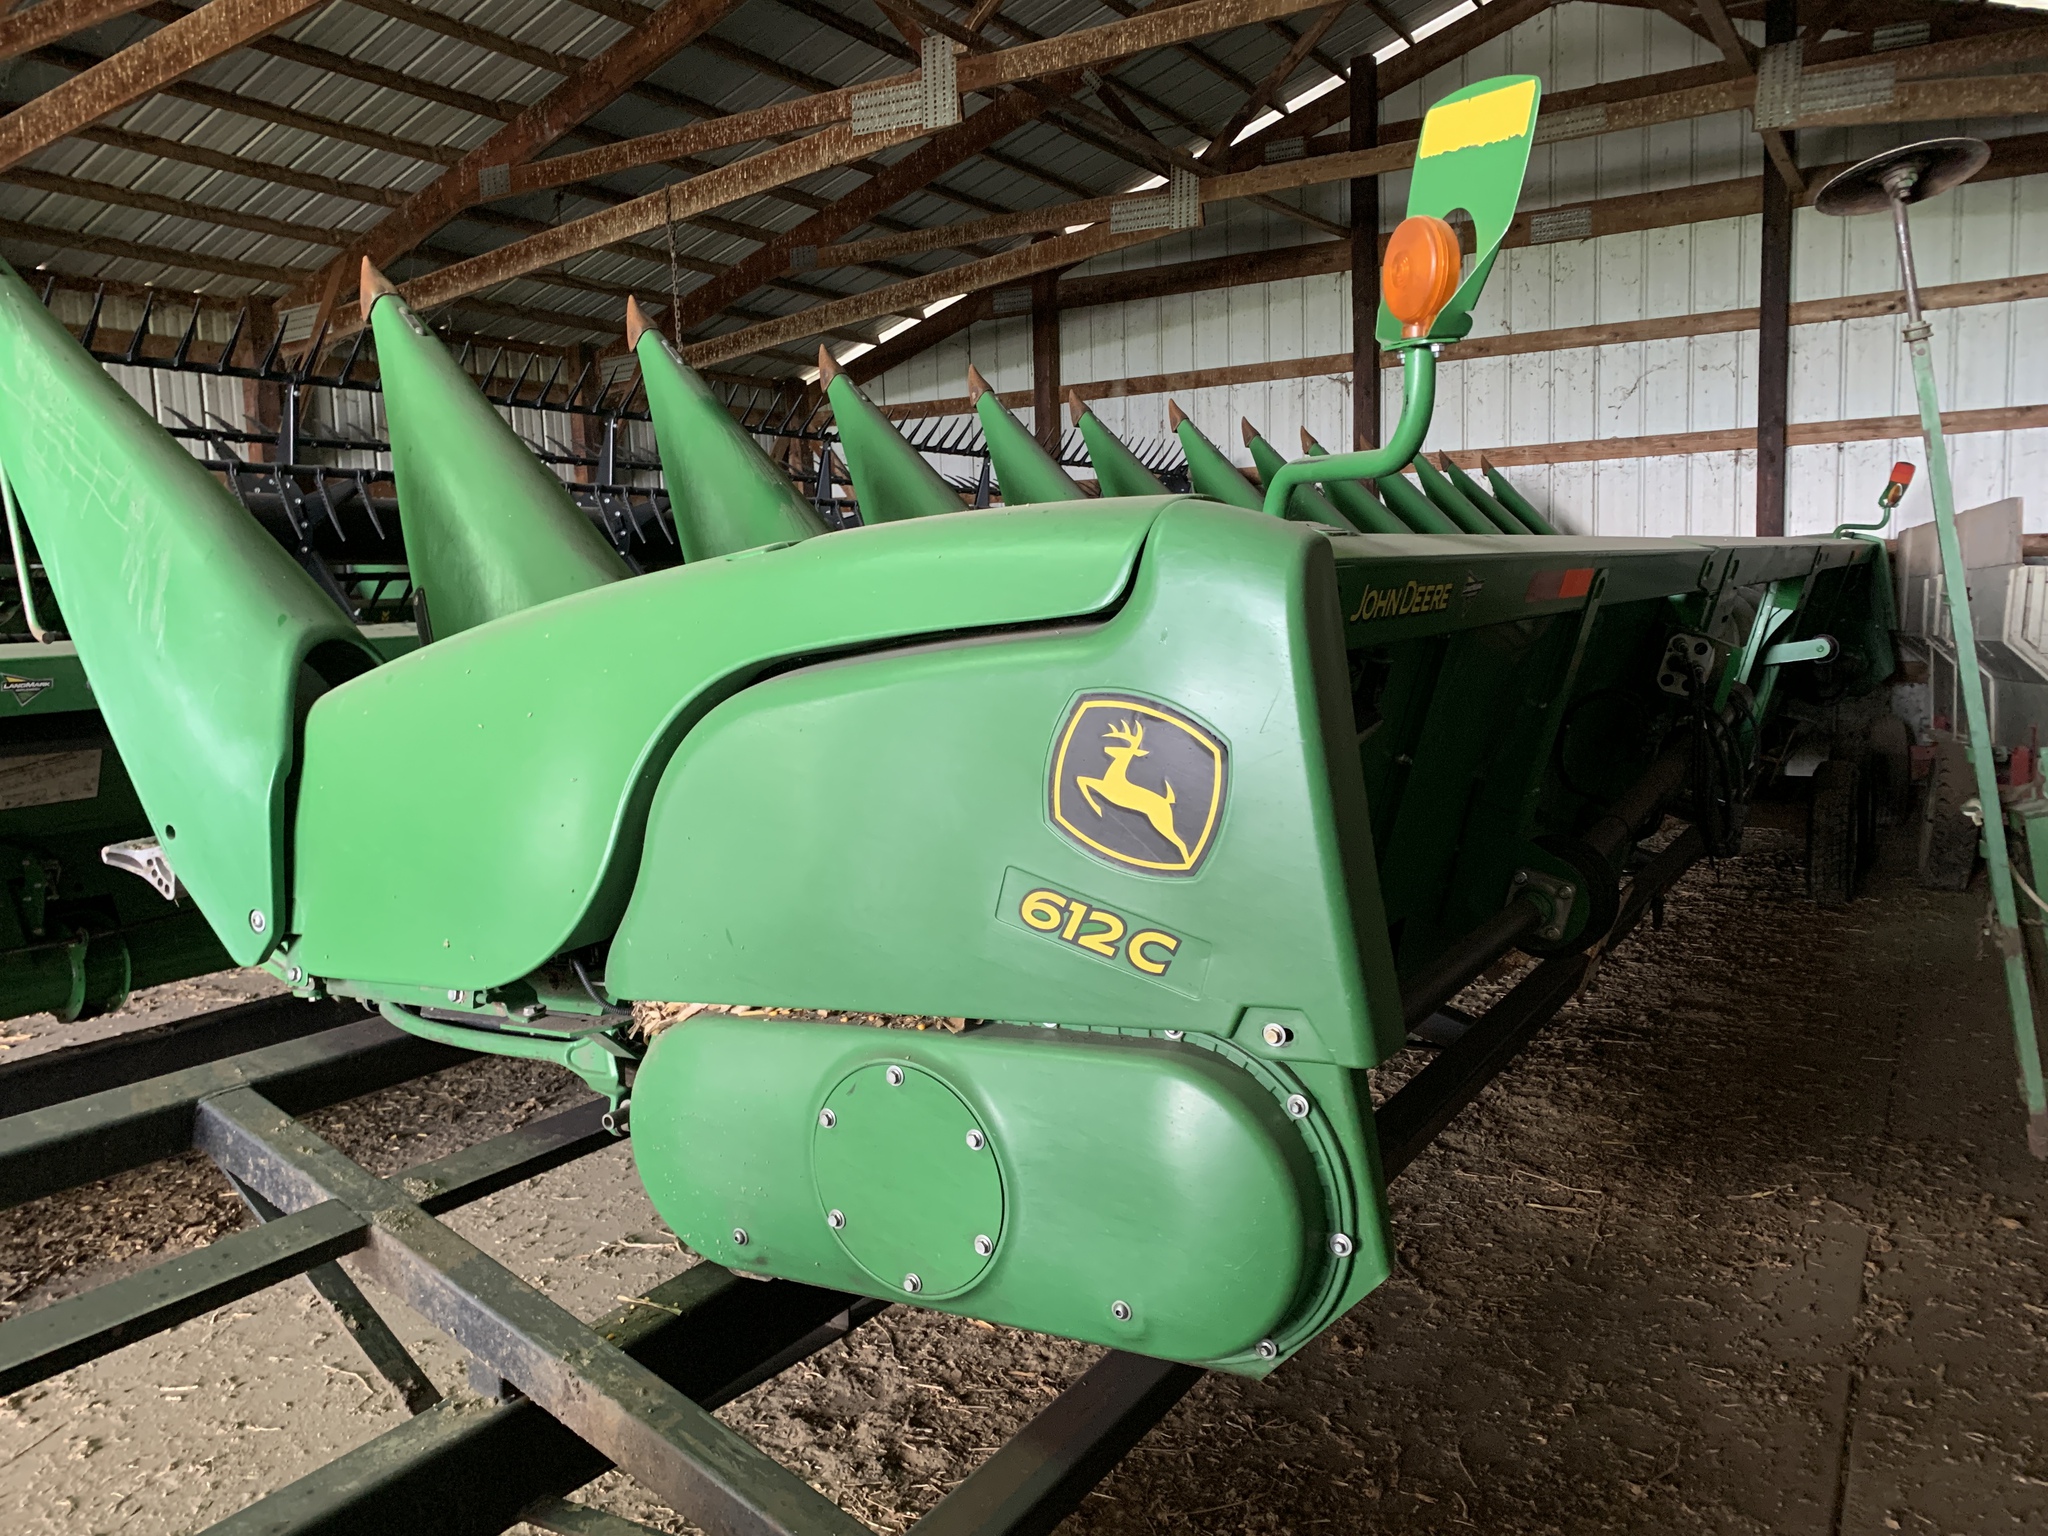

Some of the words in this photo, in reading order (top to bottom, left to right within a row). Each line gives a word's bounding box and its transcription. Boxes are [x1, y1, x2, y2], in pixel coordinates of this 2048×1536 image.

[1350, 584, 1402, 621] JOHN
[1400, 580, 1453, 614] DEERE
[1019, 887, 1182, 977] 612C
